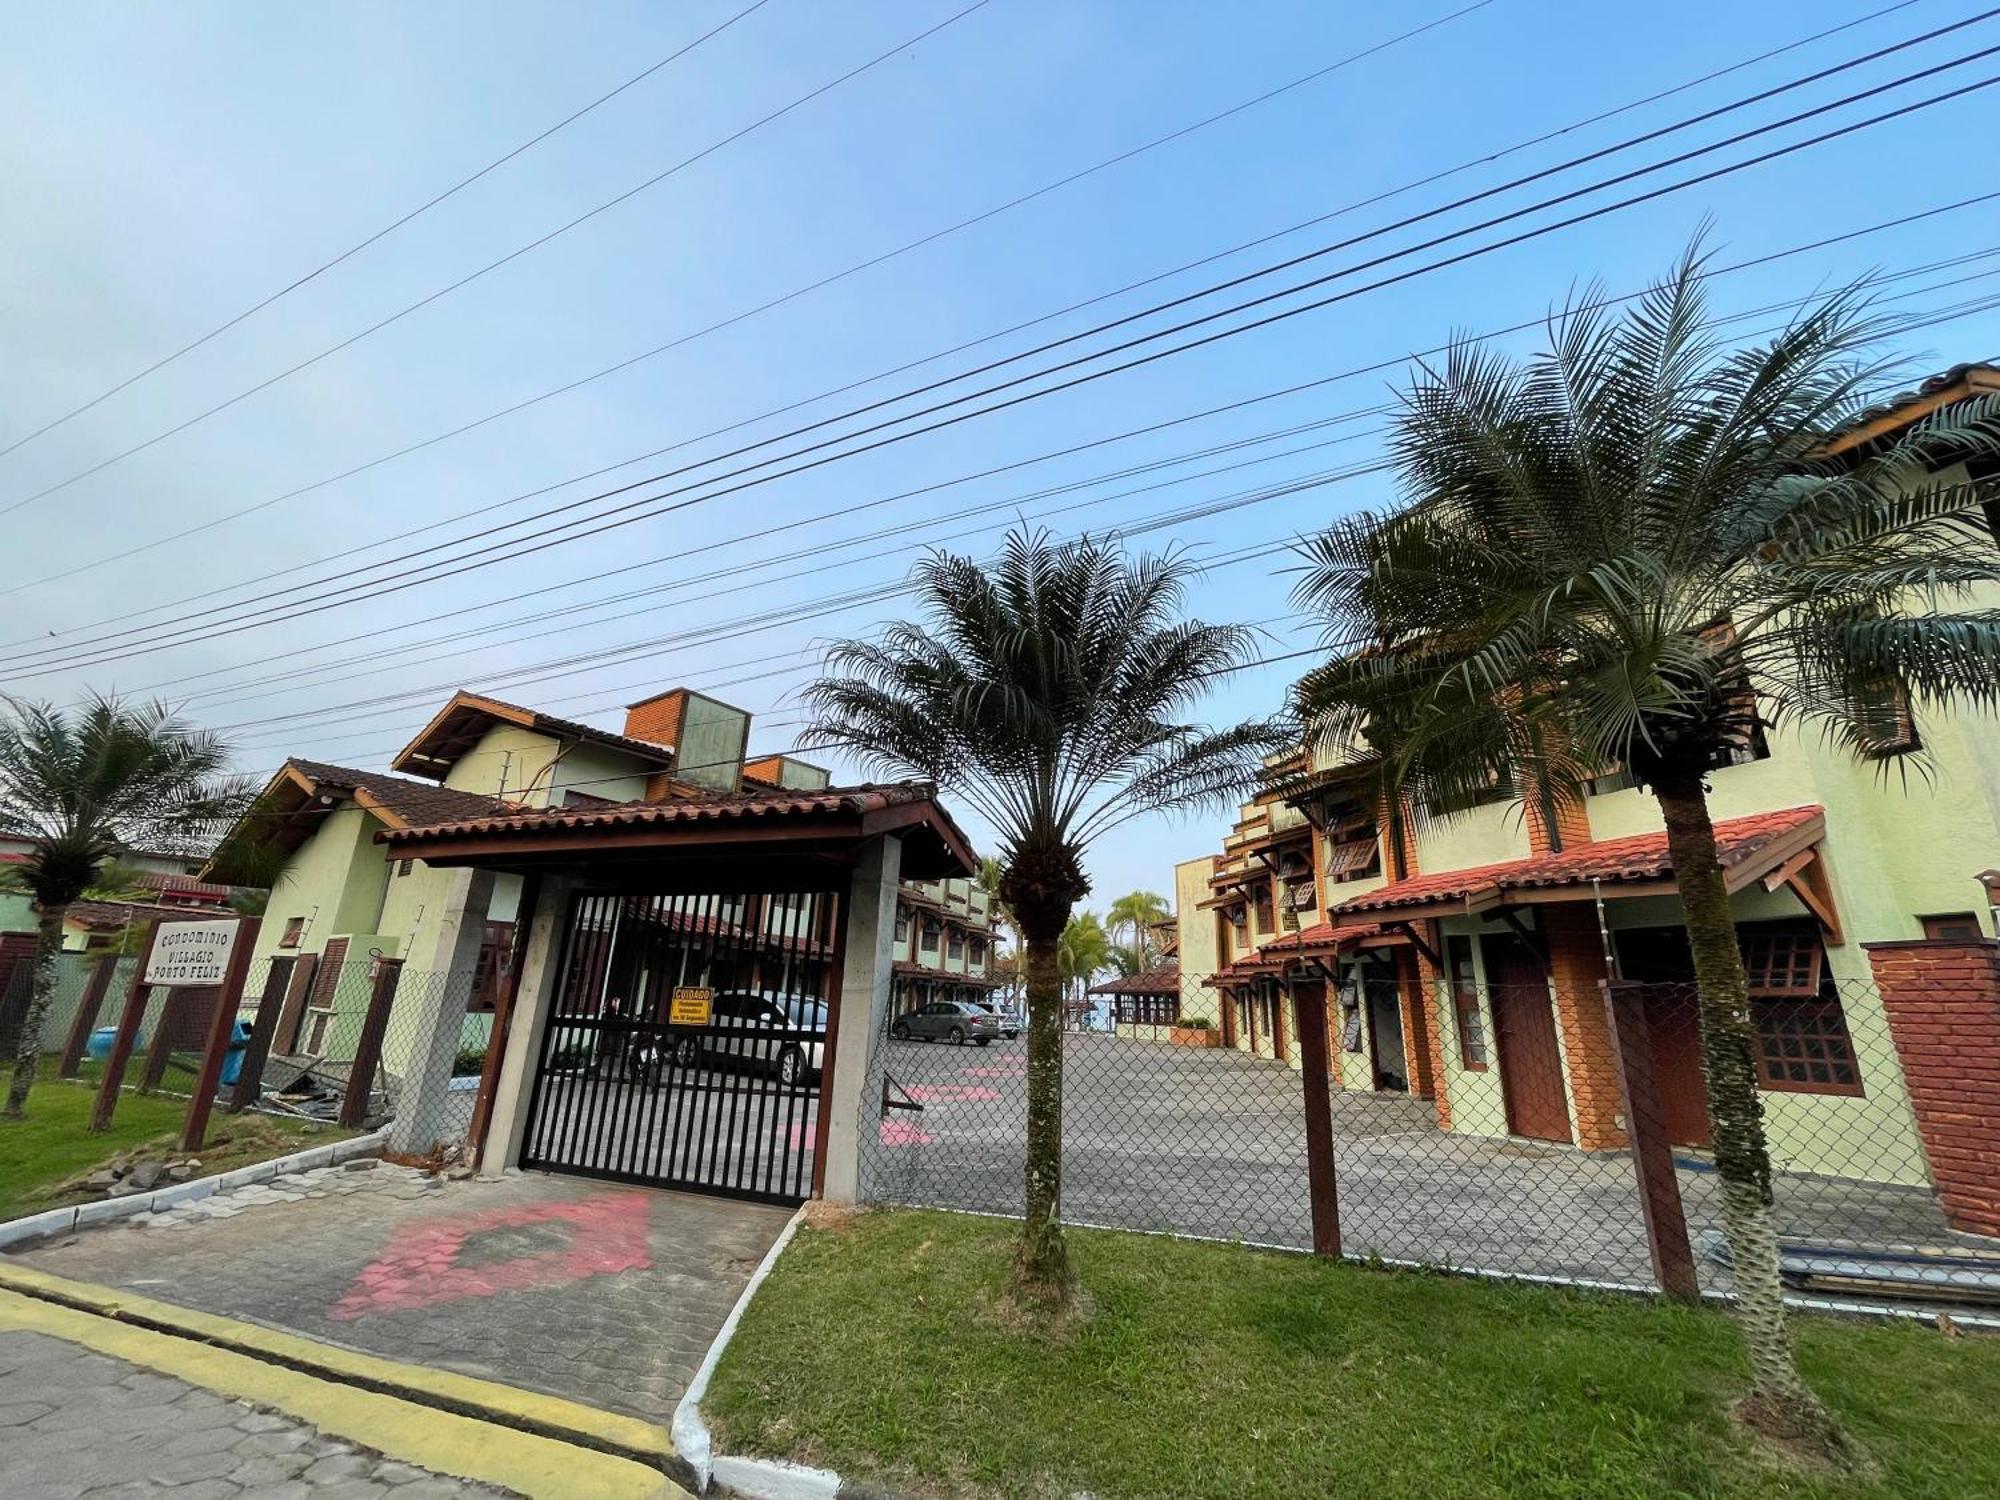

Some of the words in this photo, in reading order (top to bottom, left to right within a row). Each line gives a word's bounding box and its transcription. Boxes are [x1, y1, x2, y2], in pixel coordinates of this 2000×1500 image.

[153, 966, 186, 979] PORTO
[190, 966, 221, 978] FELIZ
[676, 989, 710, 1000] CUIDADO
